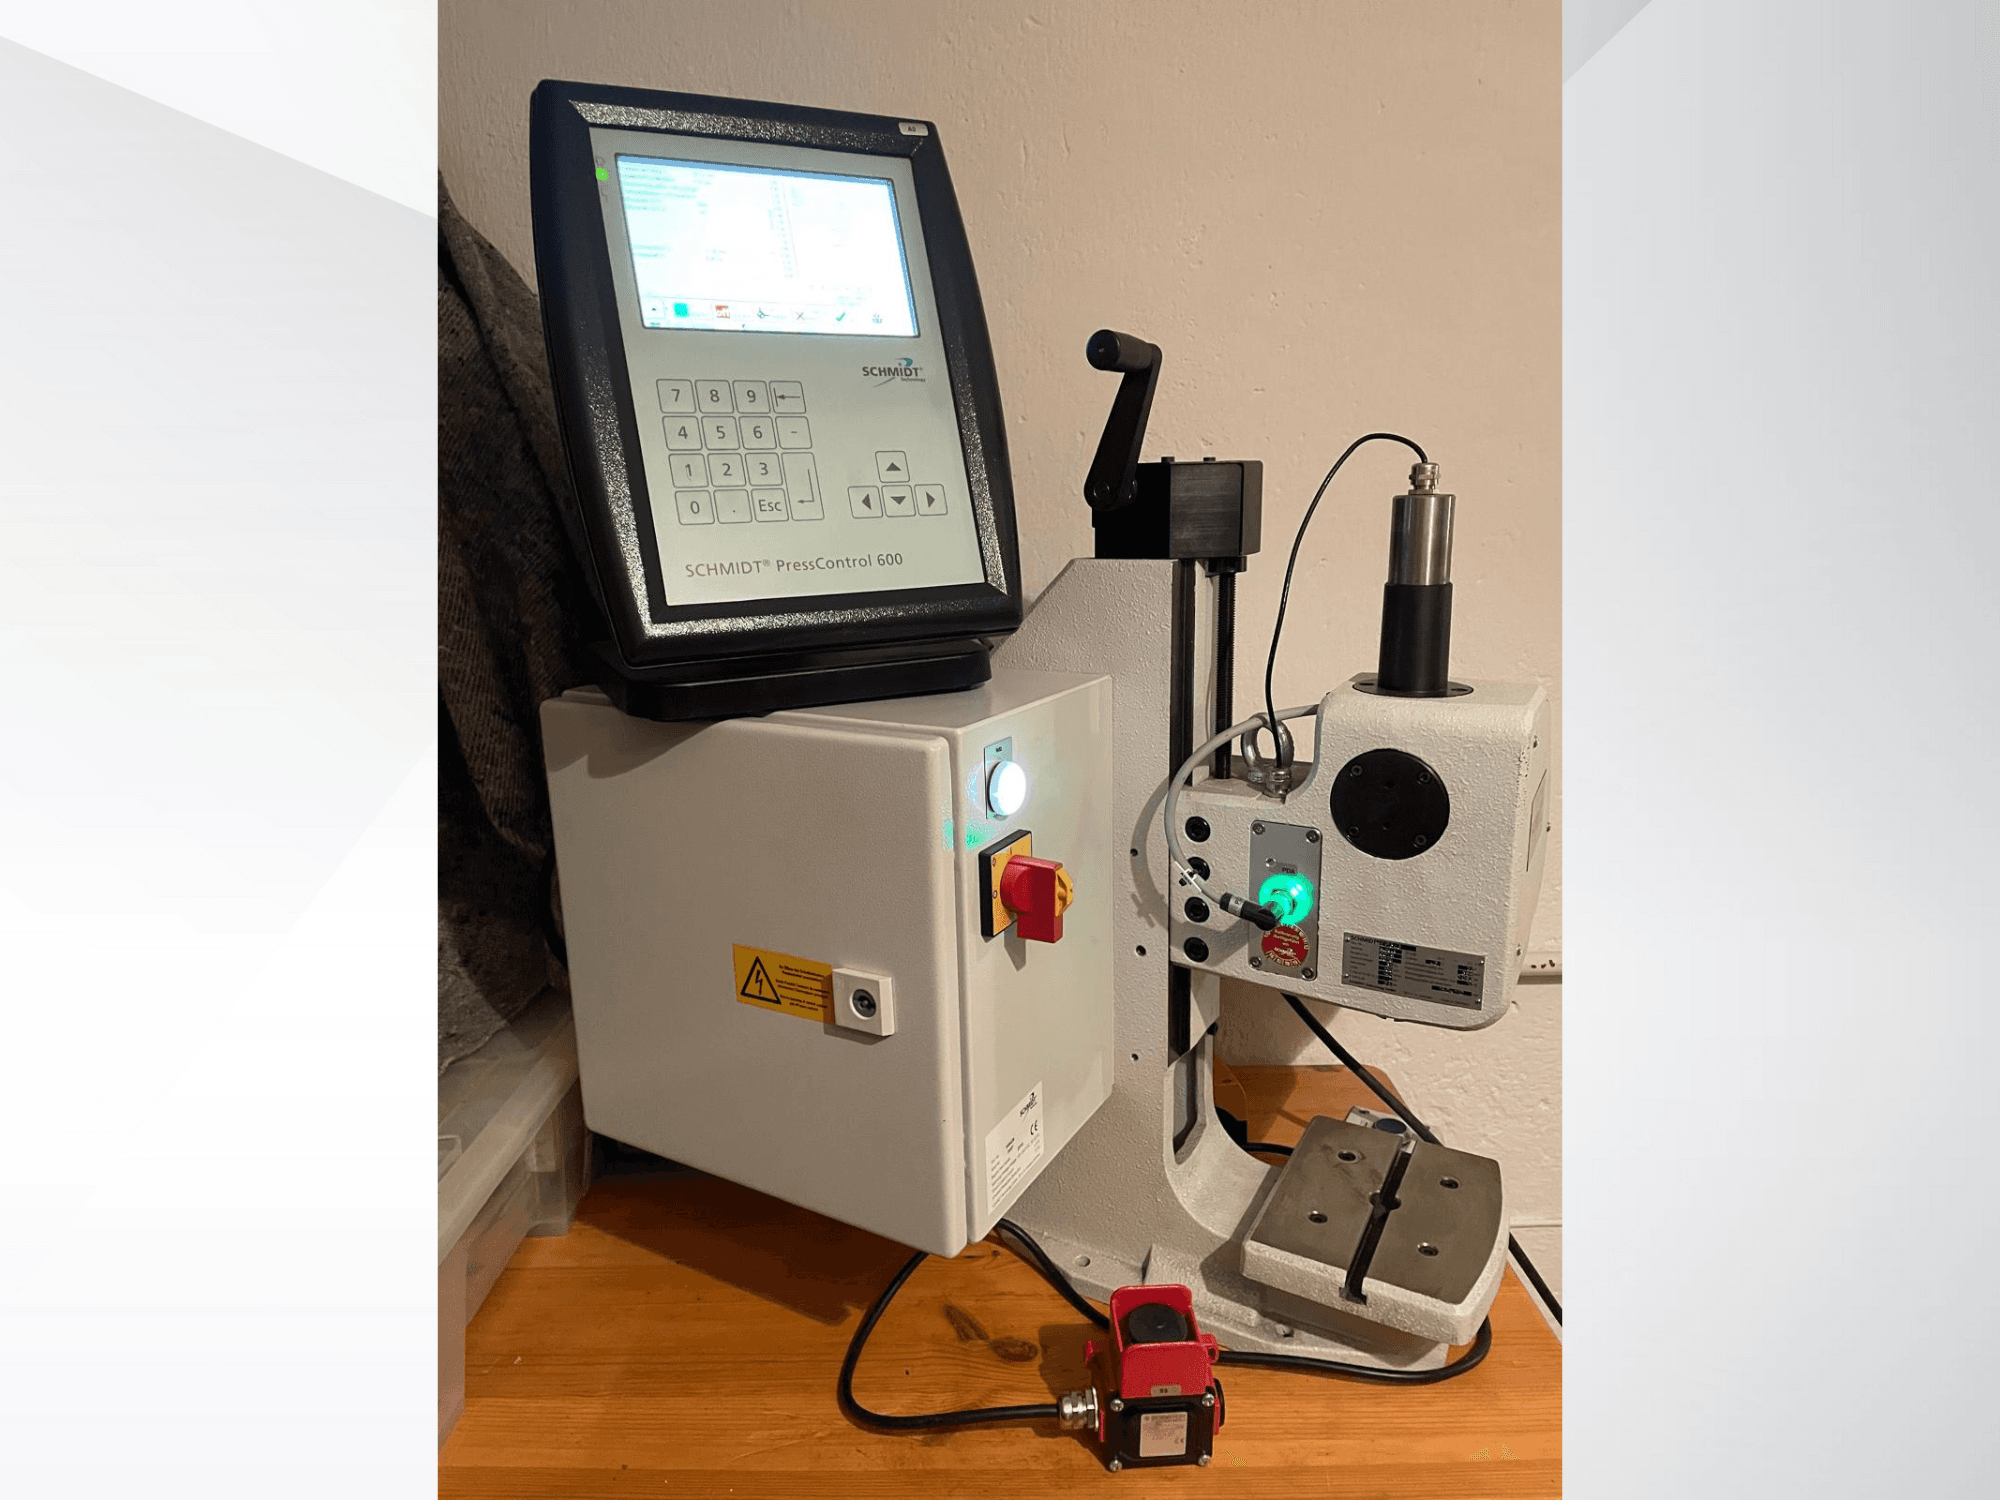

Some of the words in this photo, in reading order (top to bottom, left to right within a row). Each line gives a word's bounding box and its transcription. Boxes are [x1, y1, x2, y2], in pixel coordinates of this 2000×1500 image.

[671, 388, 681, 402] 7
[709, 389, 720, 403] 8
[746, 389, 757, 403] 9
[678, 425, 689, 439] 4
[716, 425, 726, 439] 5
[753, 425, 763, 439] 6
[684, 463, 693, 477] 1
[722, 462, 733, 476] 2
[759, 462, 769, 475] 3
[690, 501, 701, 515] 0
[758, 499, 783, 512] Esc
[776, 553, 873, 572] PressControl
[877, 552, 903, 567] 600
